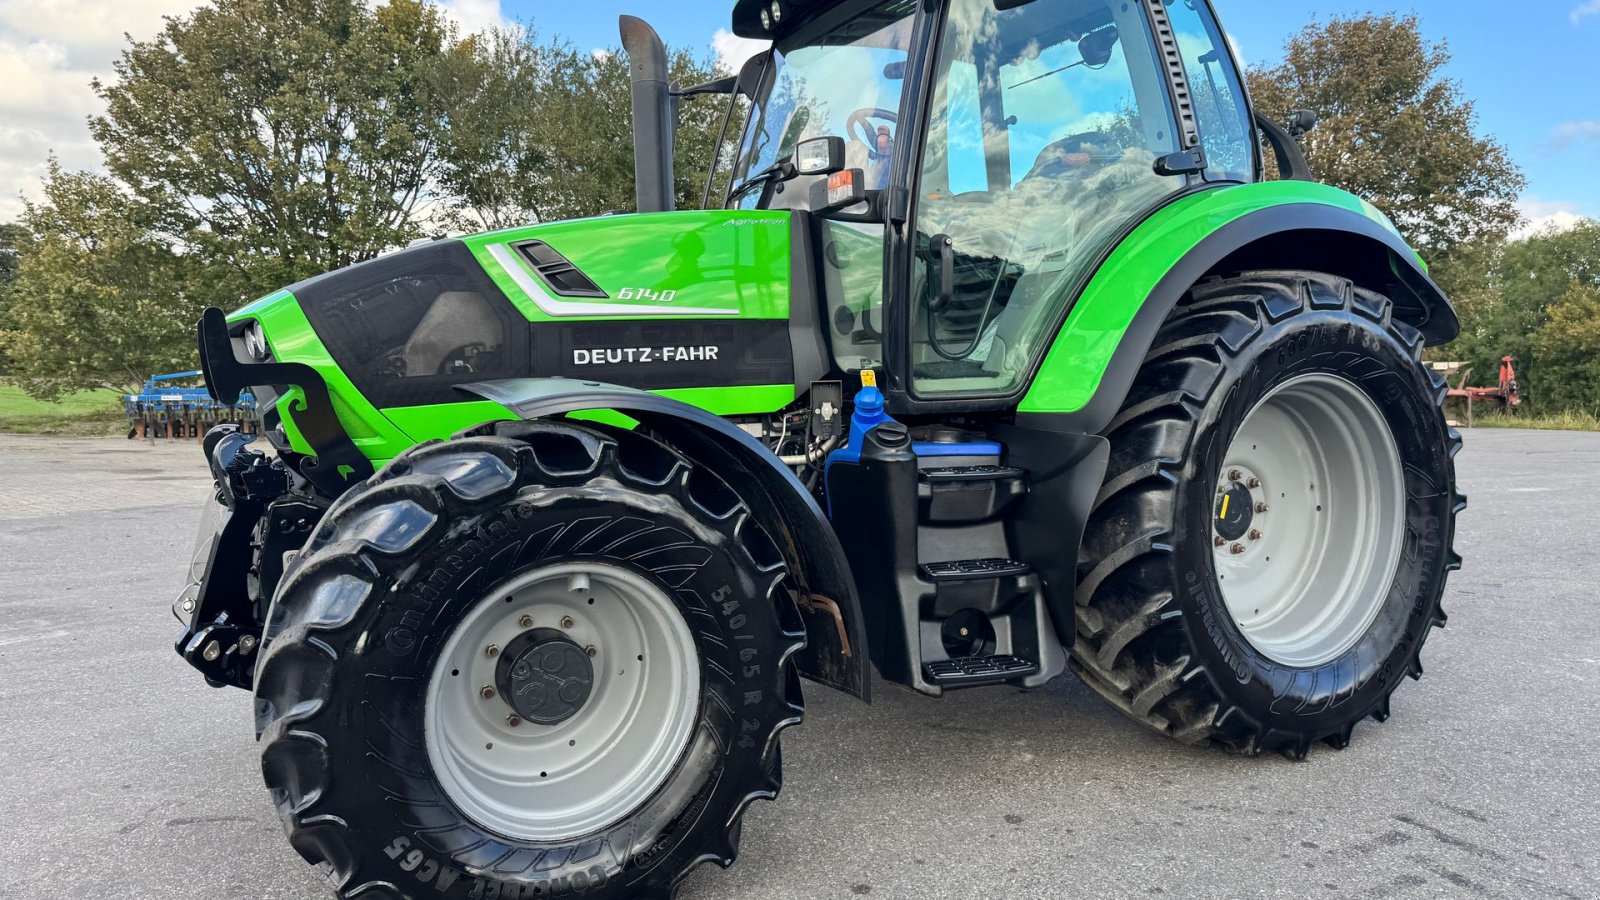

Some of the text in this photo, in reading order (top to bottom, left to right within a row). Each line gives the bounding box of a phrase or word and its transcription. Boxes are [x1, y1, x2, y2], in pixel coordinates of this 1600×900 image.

[617, 287, 678, 303] 6140
[1346, 326, 1356, 345] R
[573, 345, 720, 365] DEUTZ-FAHR
[711, 584, 763, 749] 540/65 R 24
[382, 835, 463, 893] AC65
